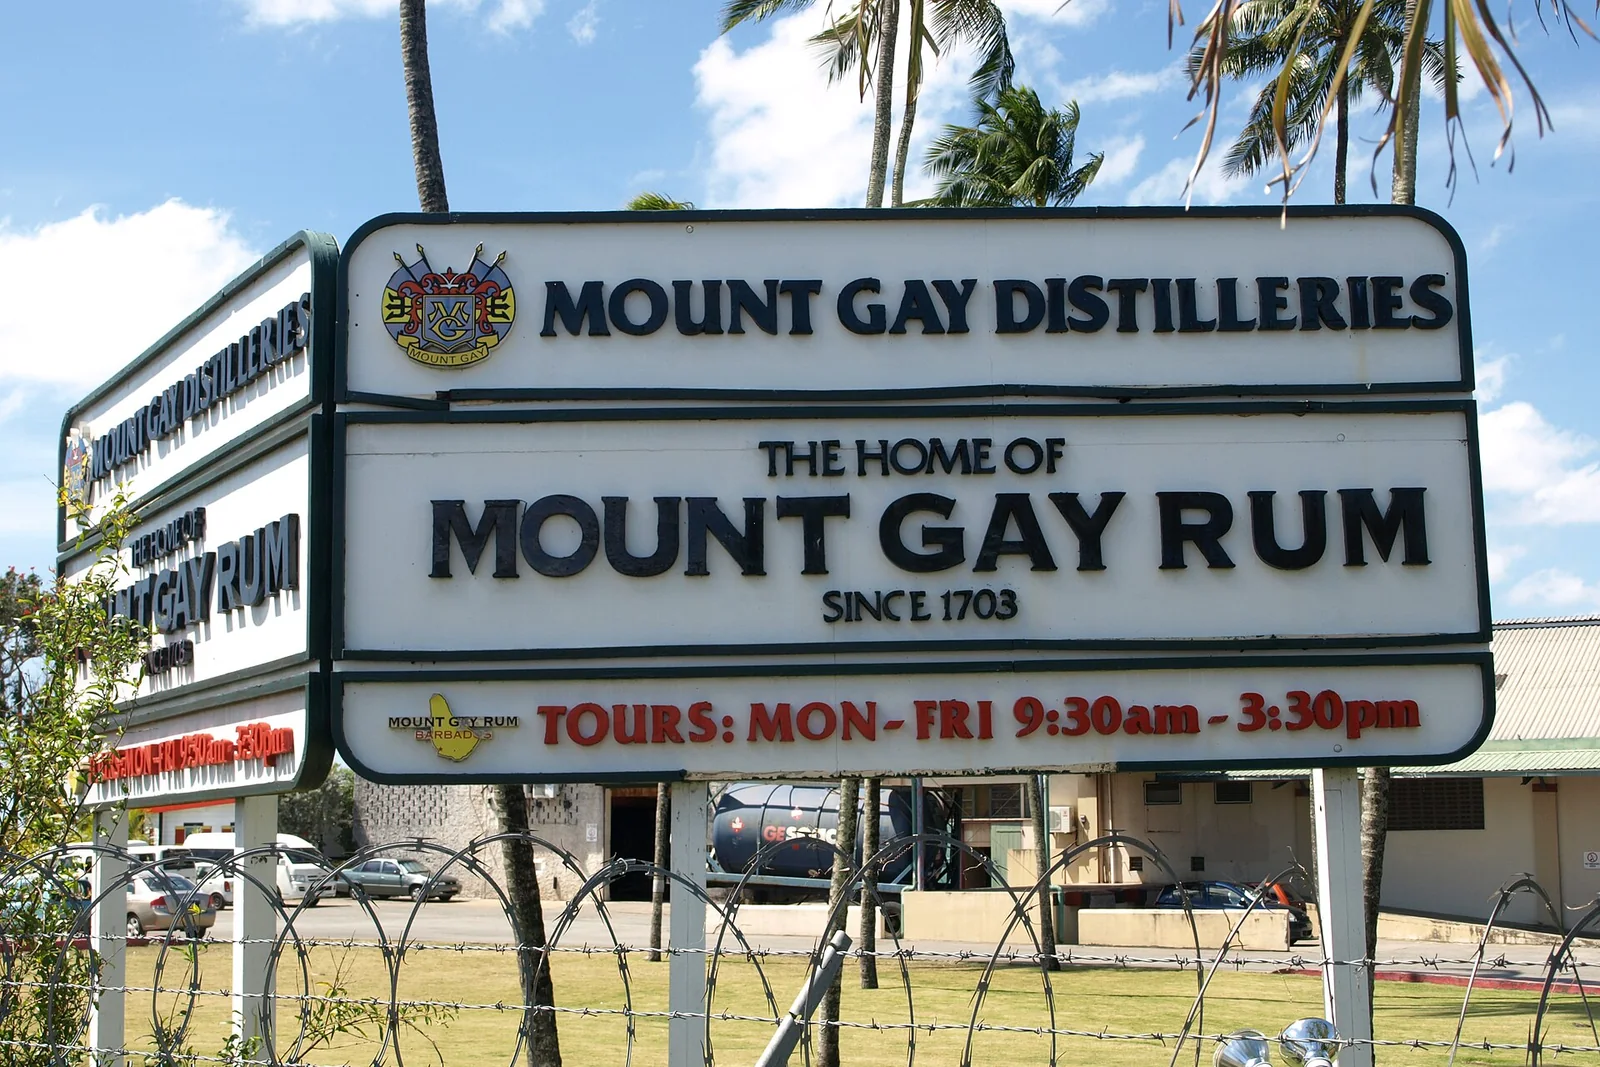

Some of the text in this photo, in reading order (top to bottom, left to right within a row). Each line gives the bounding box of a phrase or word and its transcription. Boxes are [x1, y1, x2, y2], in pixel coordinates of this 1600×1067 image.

[540, 272, 1456, 338] MOUNT GAY DISTILLERIES
[409, 348, 486, 364] MOUNT GAY
[90, 291, 312, 482] MOUNT GAY DISTILLERIES
[758, 437, 1065, 479] THE HOME OF
[150, 515, 187, 560] HOME
[181, 506, 206, 541] OF
[428, 487, 1432, 581] MOUNT GAY RUM
[154, 551, 215, 634] GAY
[216, 513, 299, 613] RUM
[822, 588, 1019, 625] SINCE 1703
[388, 716, 518, 728] MOUNT GY RUM
[537, 701, 735, 746] TOURS:
